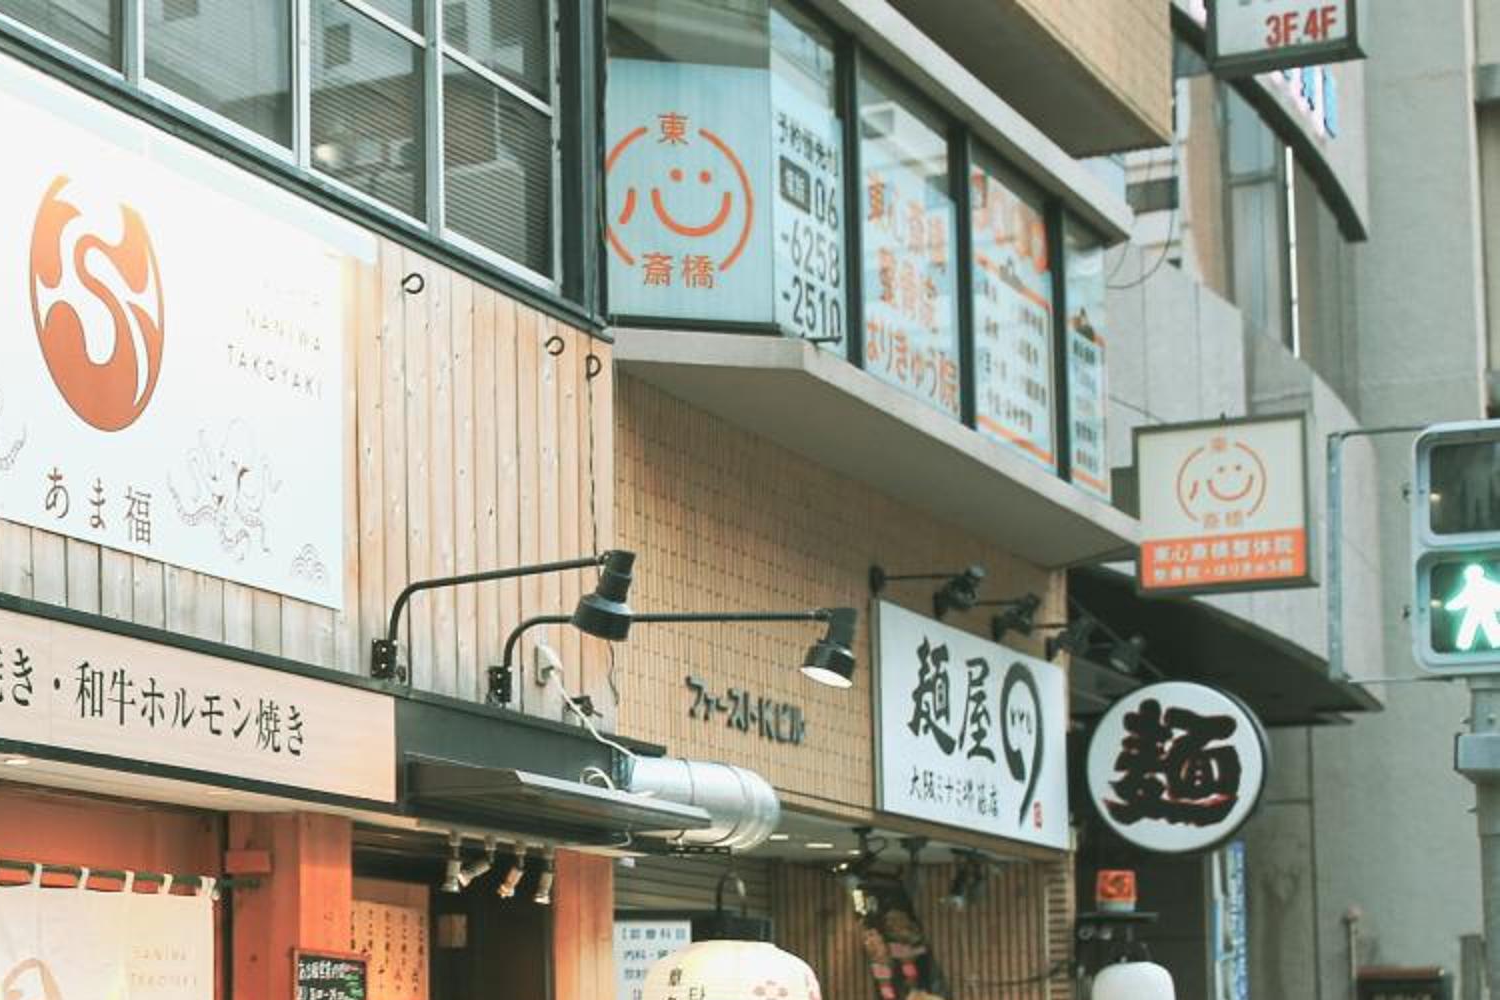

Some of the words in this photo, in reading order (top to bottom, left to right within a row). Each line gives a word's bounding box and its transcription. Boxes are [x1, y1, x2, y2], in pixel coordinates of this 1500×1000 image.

[1266, 12, 1298, 46] 3F
[1303, 5, 1337, 42] 4F
[657, 112, 690, 145] 東
[44, 466, 152, 546] あま福
